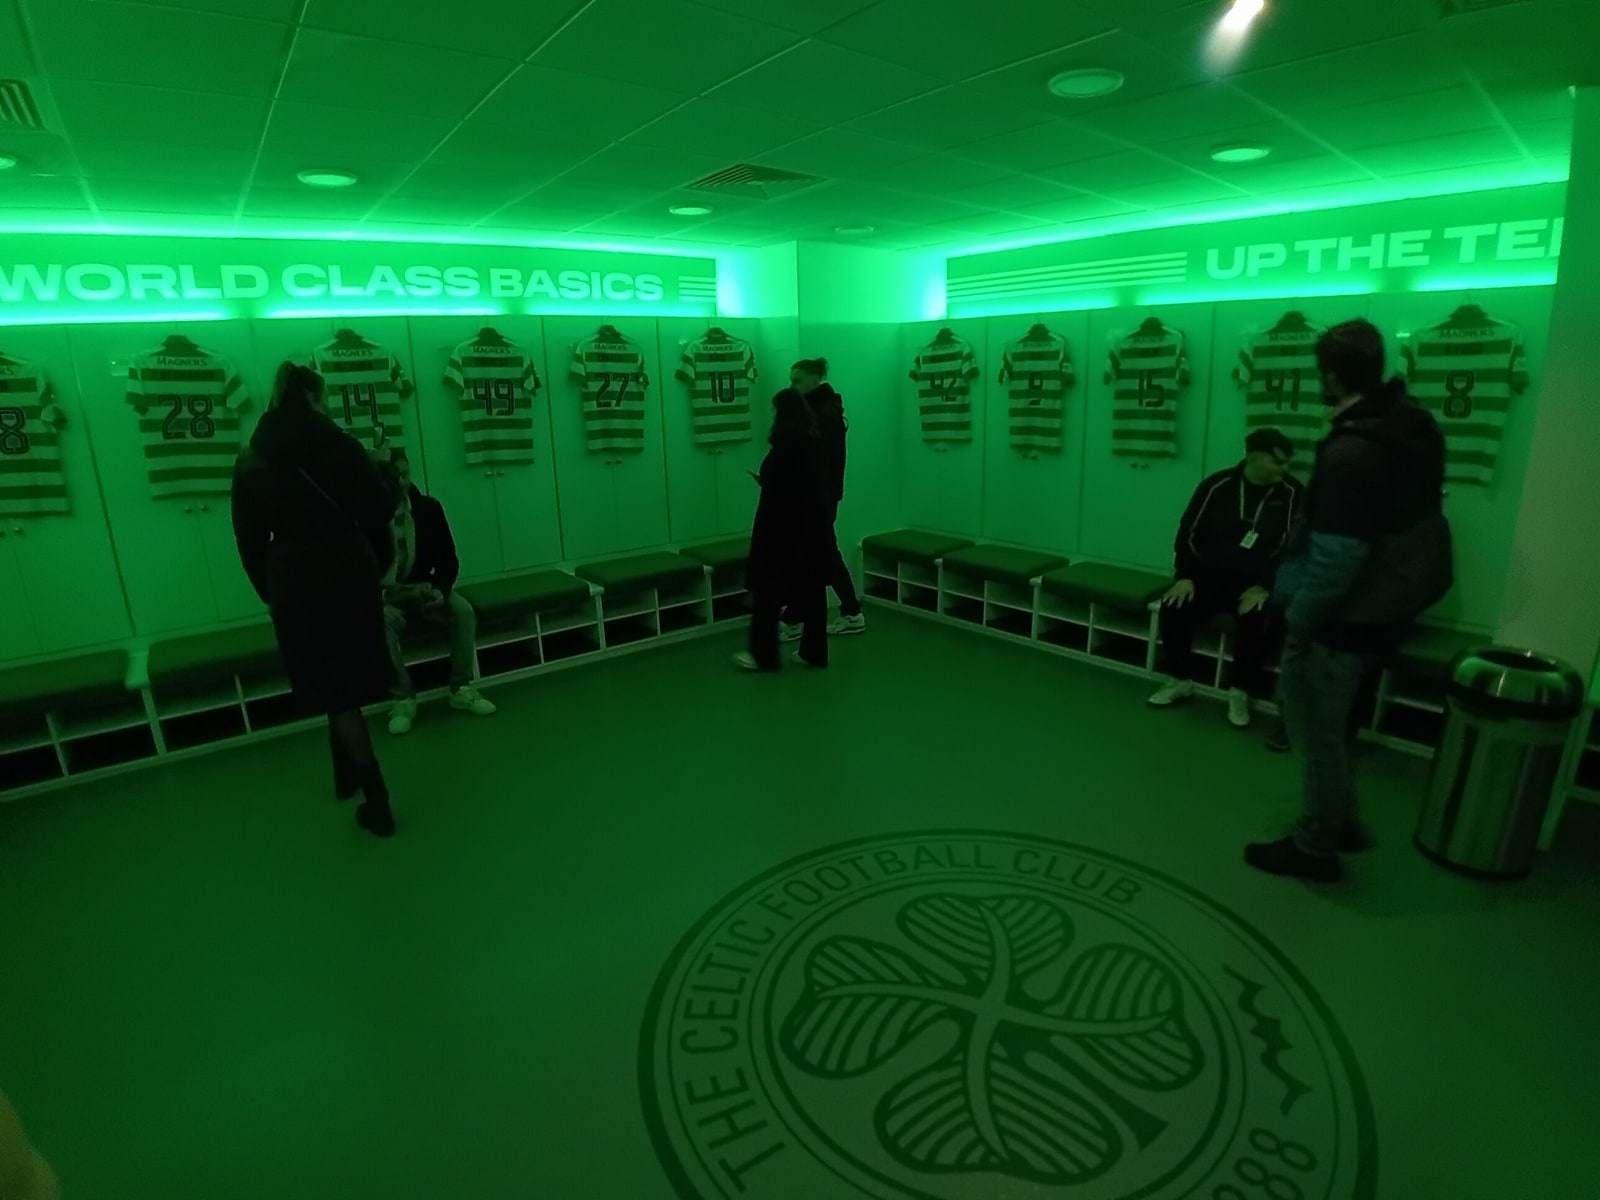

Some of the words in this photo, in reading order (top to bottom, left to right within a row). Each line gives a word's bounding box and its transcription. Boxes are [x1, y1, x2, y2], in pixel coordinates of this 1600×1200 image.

[1206, 242, 1287, 280] UP
[1294, 229, 1433, 274] THE
[0, 263, 270, 301] WORLD
[281, 263, 481, 298] CLASS
[489, 267, 664, 300] BASICS
[156, 357, 208, 367] MAGNERS
[338, 384, 378, 426] 14
[472, 378, 515, 416] 49
[594, 372, 630, 409] 27
[710, 371, 735, 404] 10
[930, 371, 957, 402] 42
[1137, 369, 1165, 407] 15
[1264, 368, 1301, 412] 41
[1443, 370, 1475, 418] 8
[158, 394, 215, 440] 28
[756, 844, 997, 921] FOOTBALL
[1012, 848, 1143, 905] CLUB
[679, 919, 776, 1054] CELTIC
[684, 1066, 786, 1194] THE
